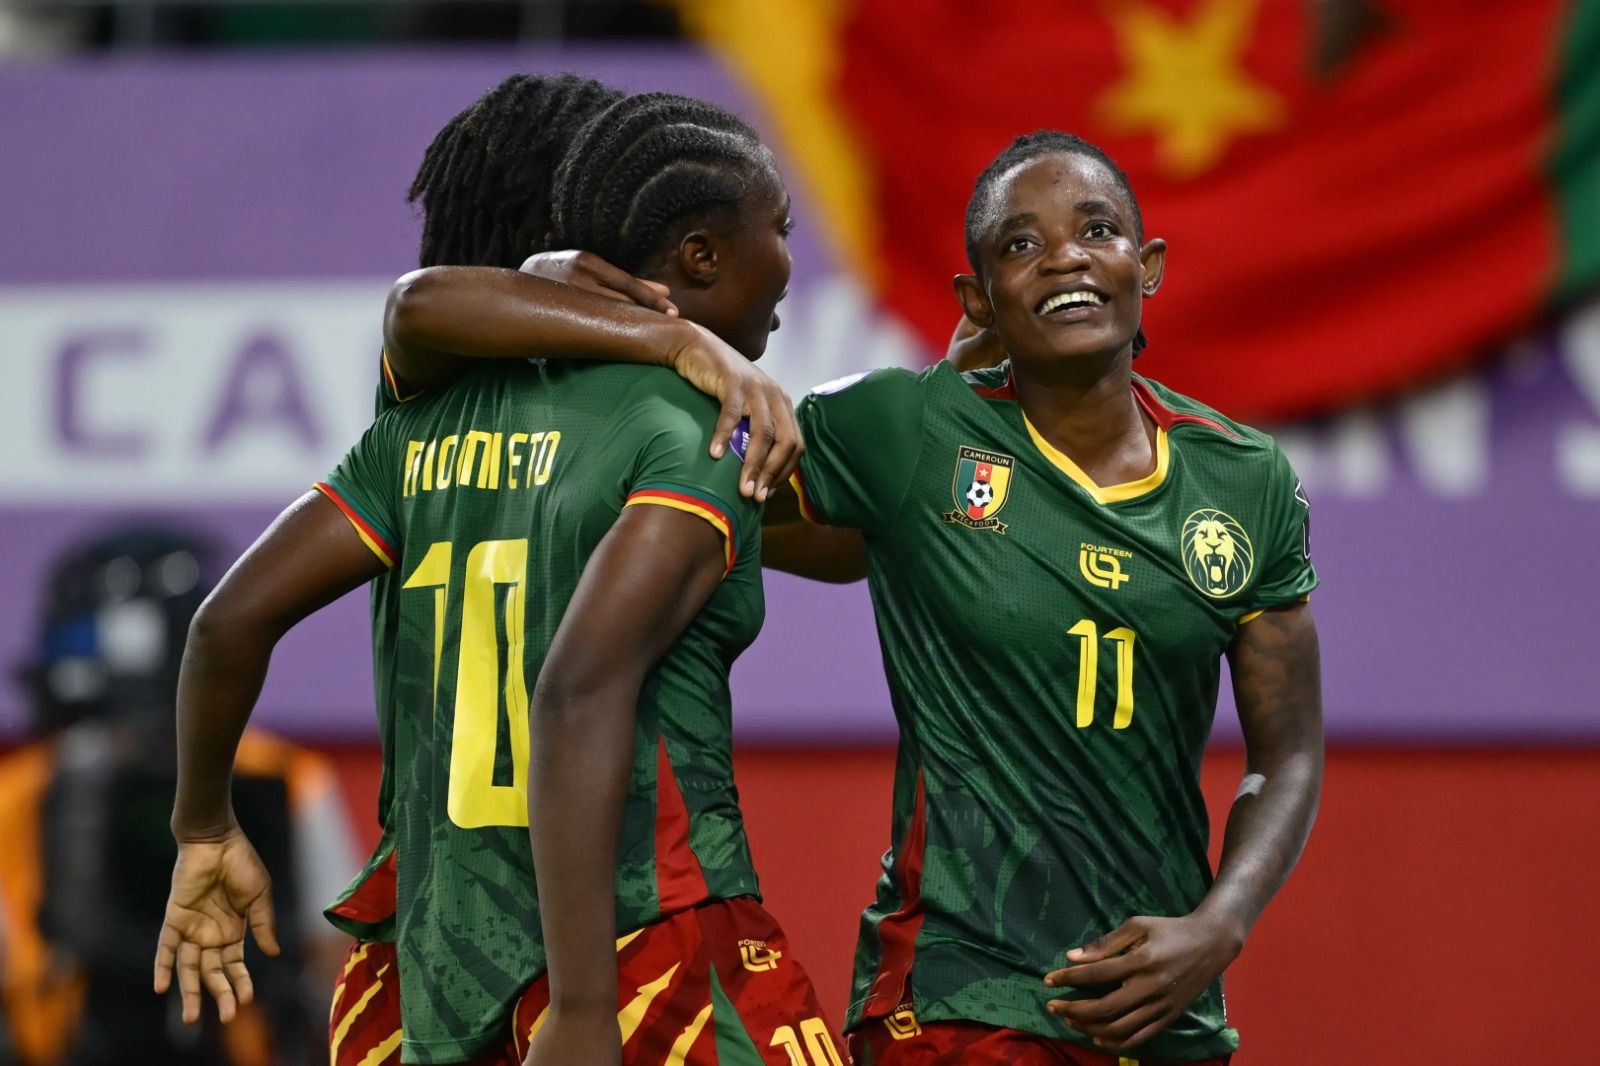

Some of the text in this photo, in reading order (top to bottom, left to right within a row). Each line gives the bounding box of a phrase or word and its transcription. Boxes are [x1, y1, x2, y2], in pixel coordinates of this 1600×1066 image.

[48, 324, 384, 462] CA
[963, 449, 1010, 466] CAMEROUN
[1080, 542, 1133, 559] FOURTEEN
[402, 538, 531, 829] 10
[1067, 619, 1136, 730] 11
